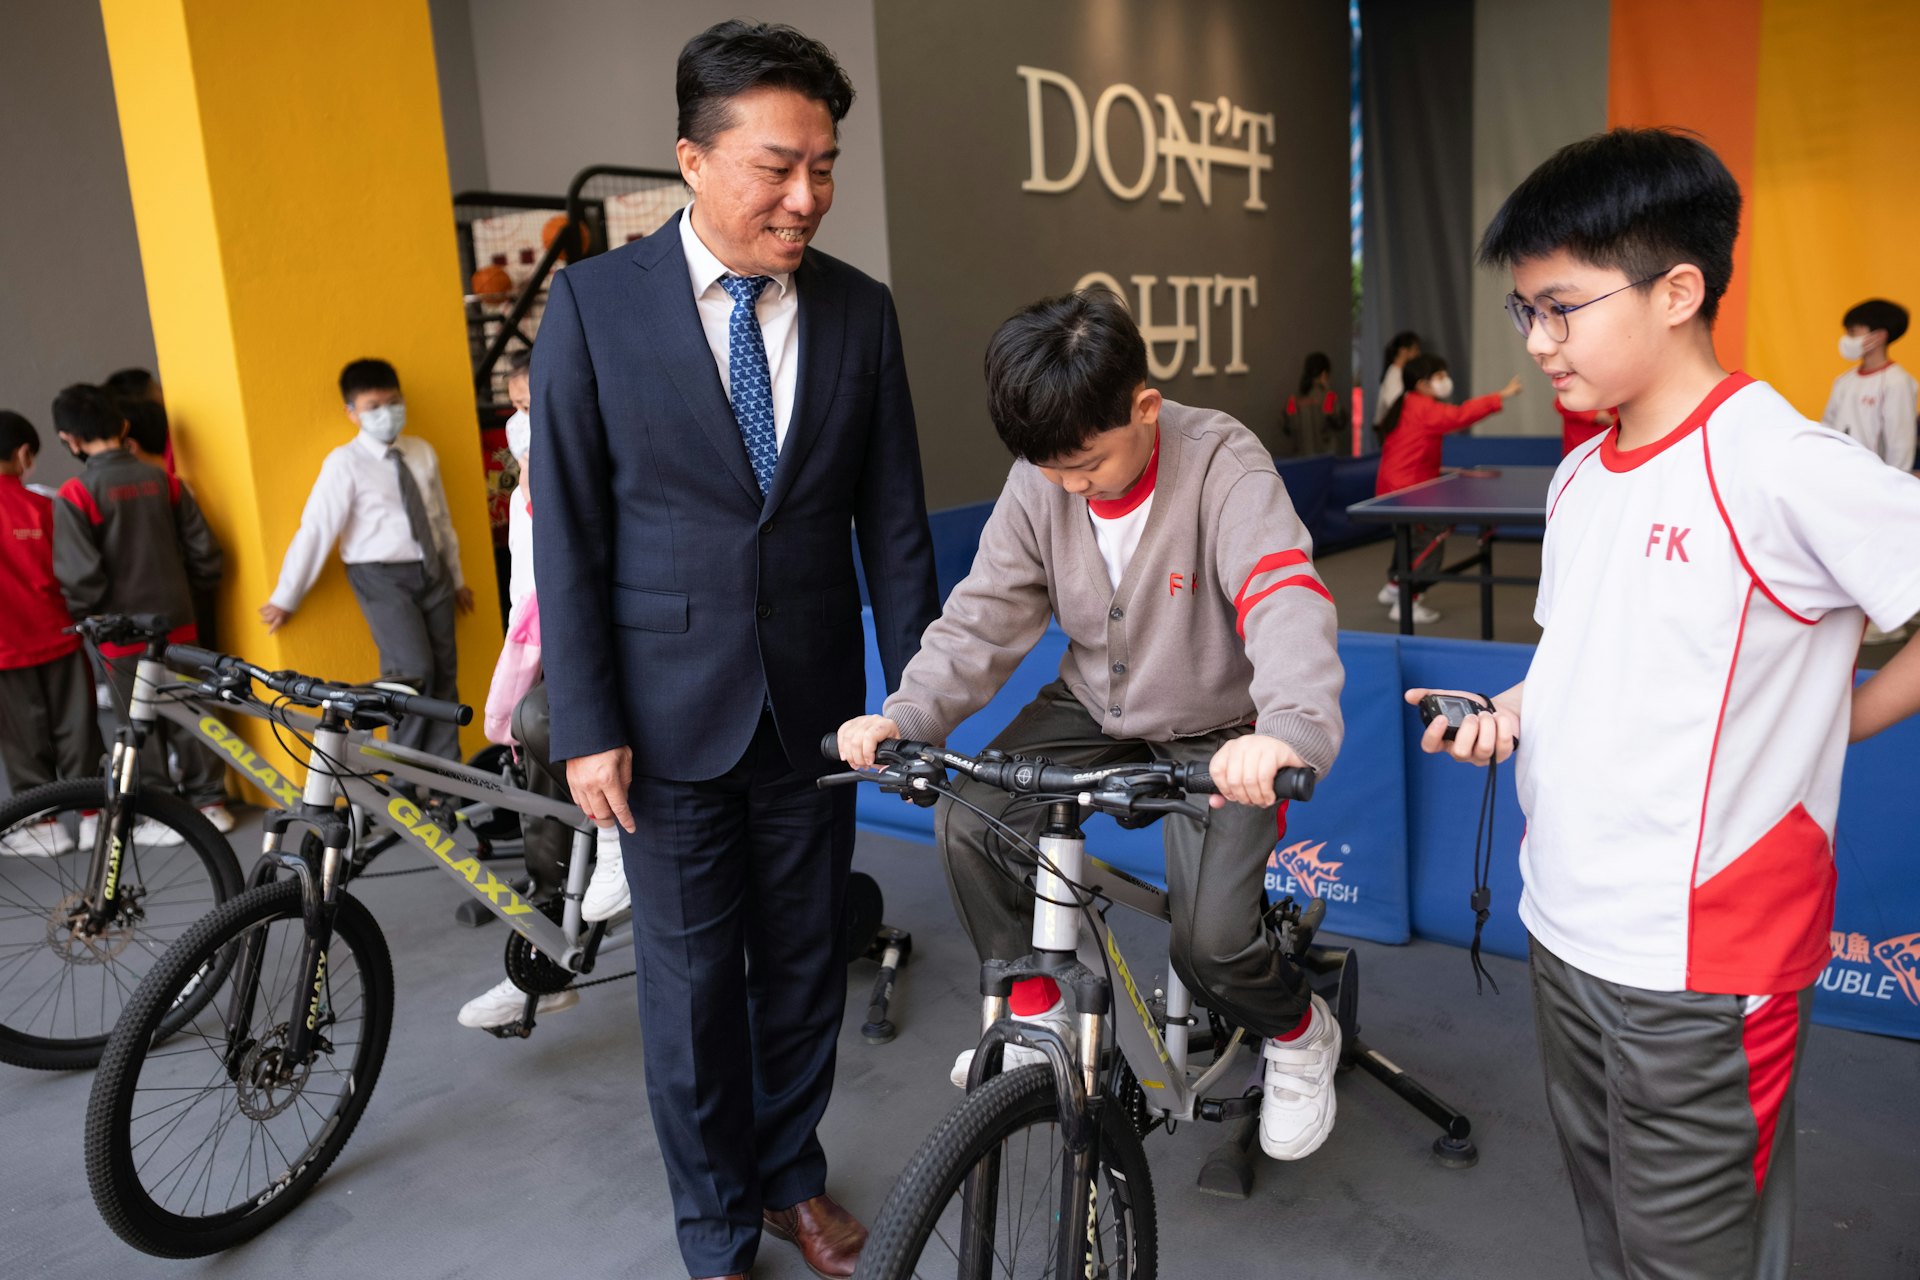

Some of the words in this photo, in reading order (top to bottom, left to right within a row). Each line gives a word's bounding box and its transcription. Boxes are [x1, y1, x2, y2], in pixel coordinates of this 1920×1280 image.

[1016, 64, 1275, 211] DON'T
[1072, 271, 1258, 381] UIT
[1645, 522, 1692, 563] FK
[198, 716, 303, 807] GALAX
[104, 834, 123, 901] GALAXY
[387, 797, 534, 916] GALAXY
[1317, 880, 1359, 904] FISH
[306, 949, 328, 1031] GALAXY
[1814, 966, 1897, 1000] UBLE
